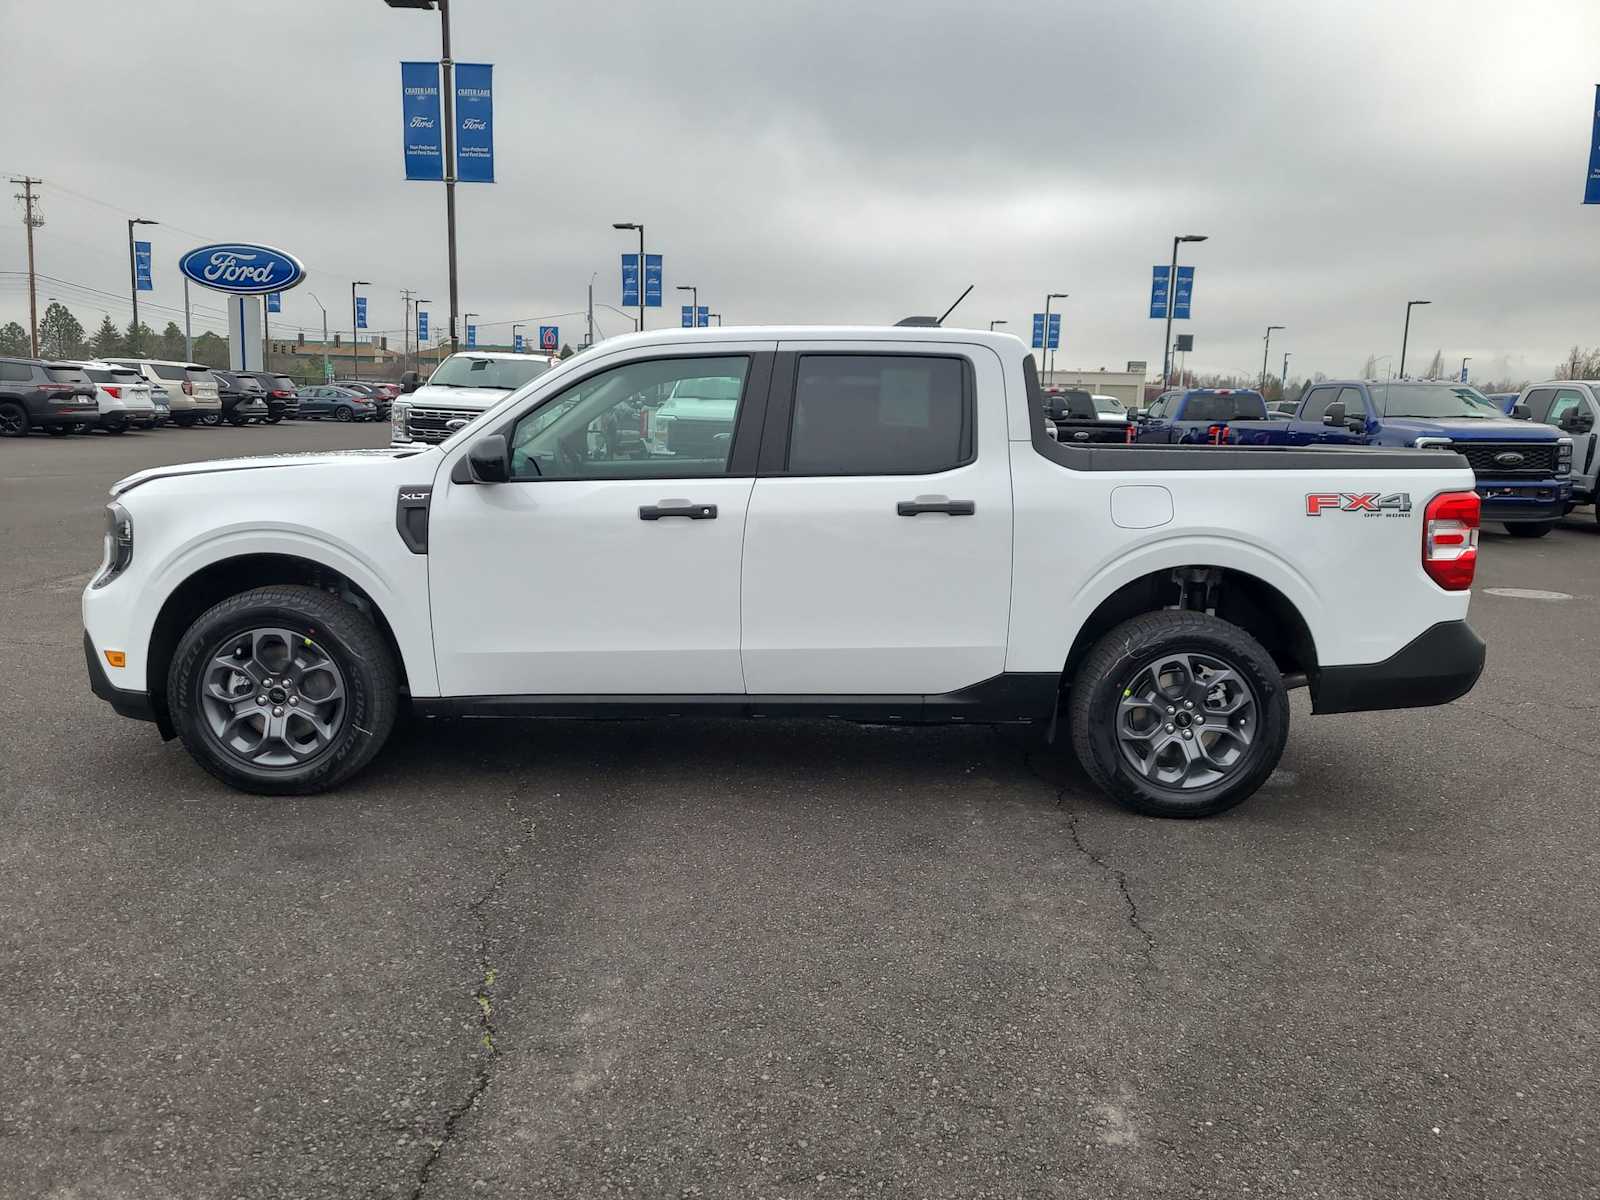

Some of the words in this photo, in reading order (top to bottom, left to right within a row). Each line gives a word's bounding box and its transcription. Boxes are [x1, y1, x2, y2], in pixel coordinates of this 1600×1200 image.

[409, 116, 434, 128] Ford
[462, 118, 486, 130] Ford
[203, 251, 275, 282] Ford
[543, 327, 556, 345] 6
[1305, 492, 1412, 516] FX4
